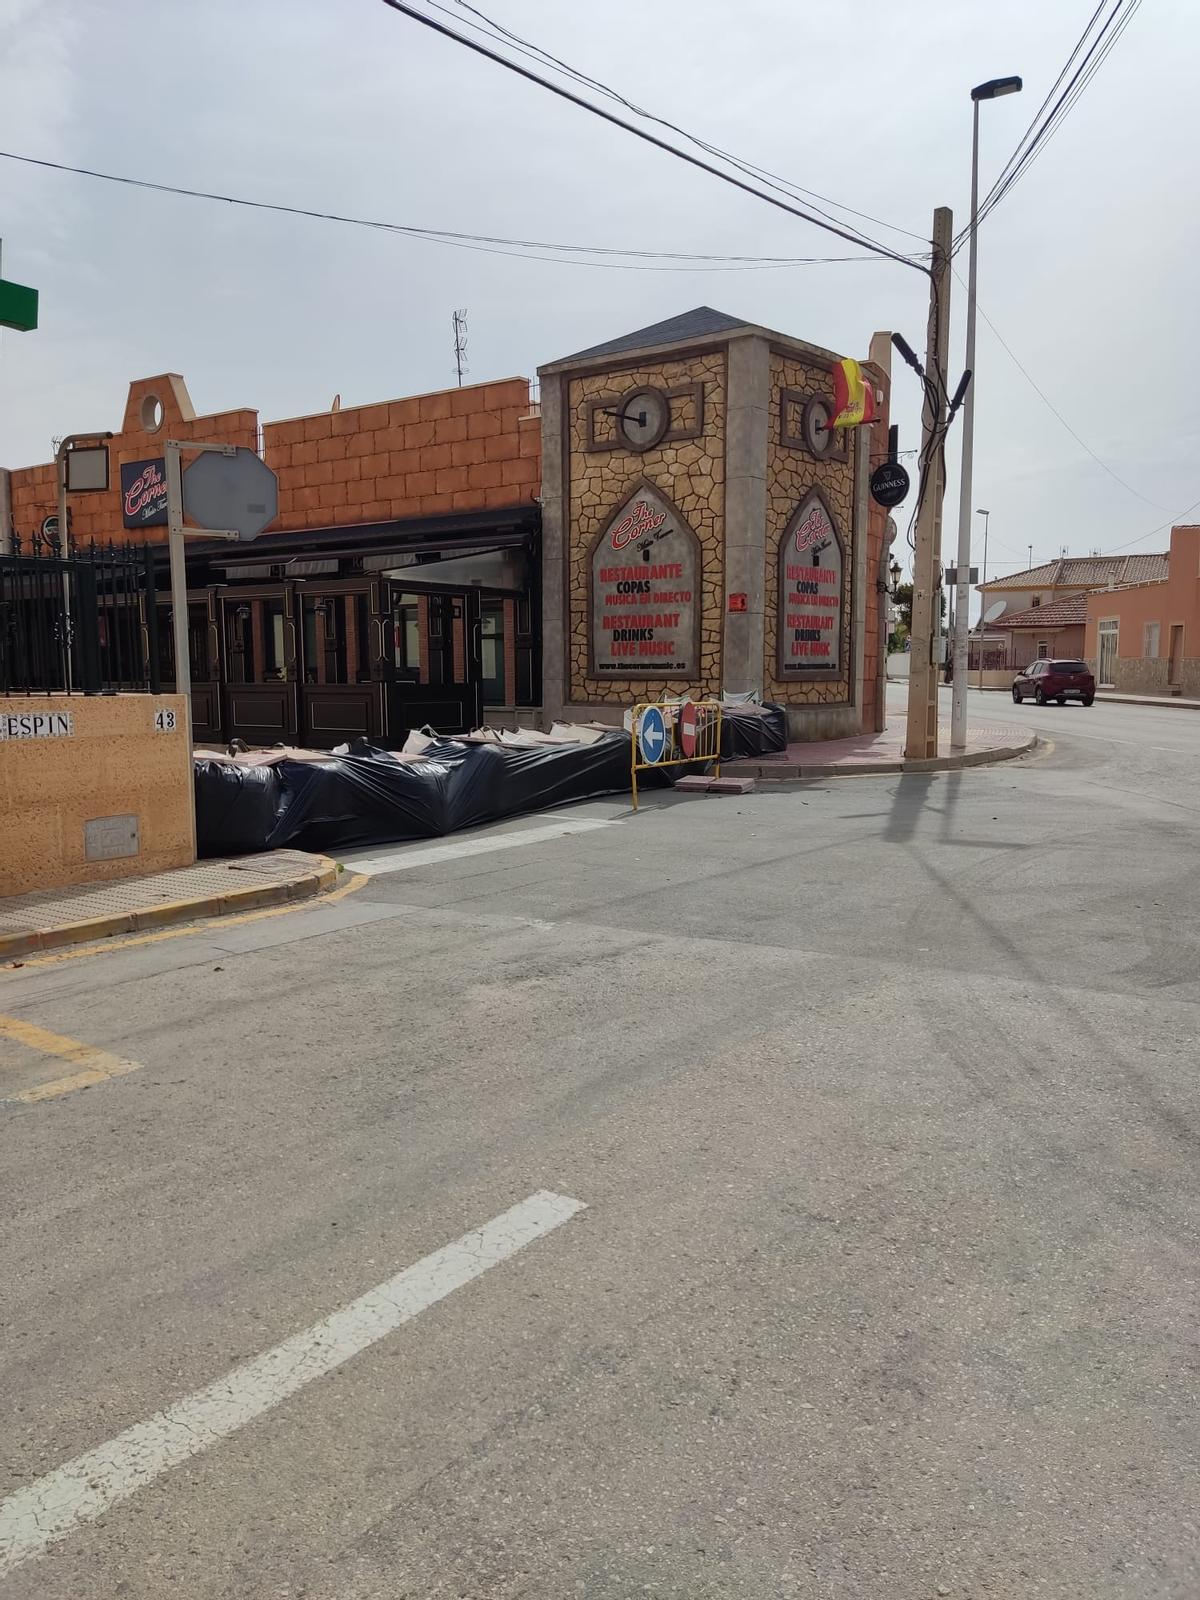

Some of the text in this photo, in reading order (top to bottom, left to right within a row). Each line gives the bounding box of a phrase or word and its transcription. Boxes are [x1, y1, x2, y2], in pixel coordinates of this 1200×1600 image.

[143, 464, 162, 488] The
[873, 479, 906, 492] GUINNESS
[125, 478, 168, 516] Corne
[632, 502, 654, 525] The
[611, 512, 667, 550] Corner
[600, 564, 682, 581] RESTAURANTE
[617, 580, 651, 594] COPAS
[796, 581, 819, 595] COPAS
[605, 593, 638, 606] MUSICA
[653, 590, 692, 604] DIRECTO
[603, 613, 681, 630] RESTAURANT
[613, 629, 654, 642] DRINKS
[795, 629, 821, 642] DRINKS
[611, 640, 676, 657] LIVE MUSIC
[791, 642, 808, 657] LIVE
[7, 716, 69, 737] ESPIN
[156, 712, 175, 729] 43
